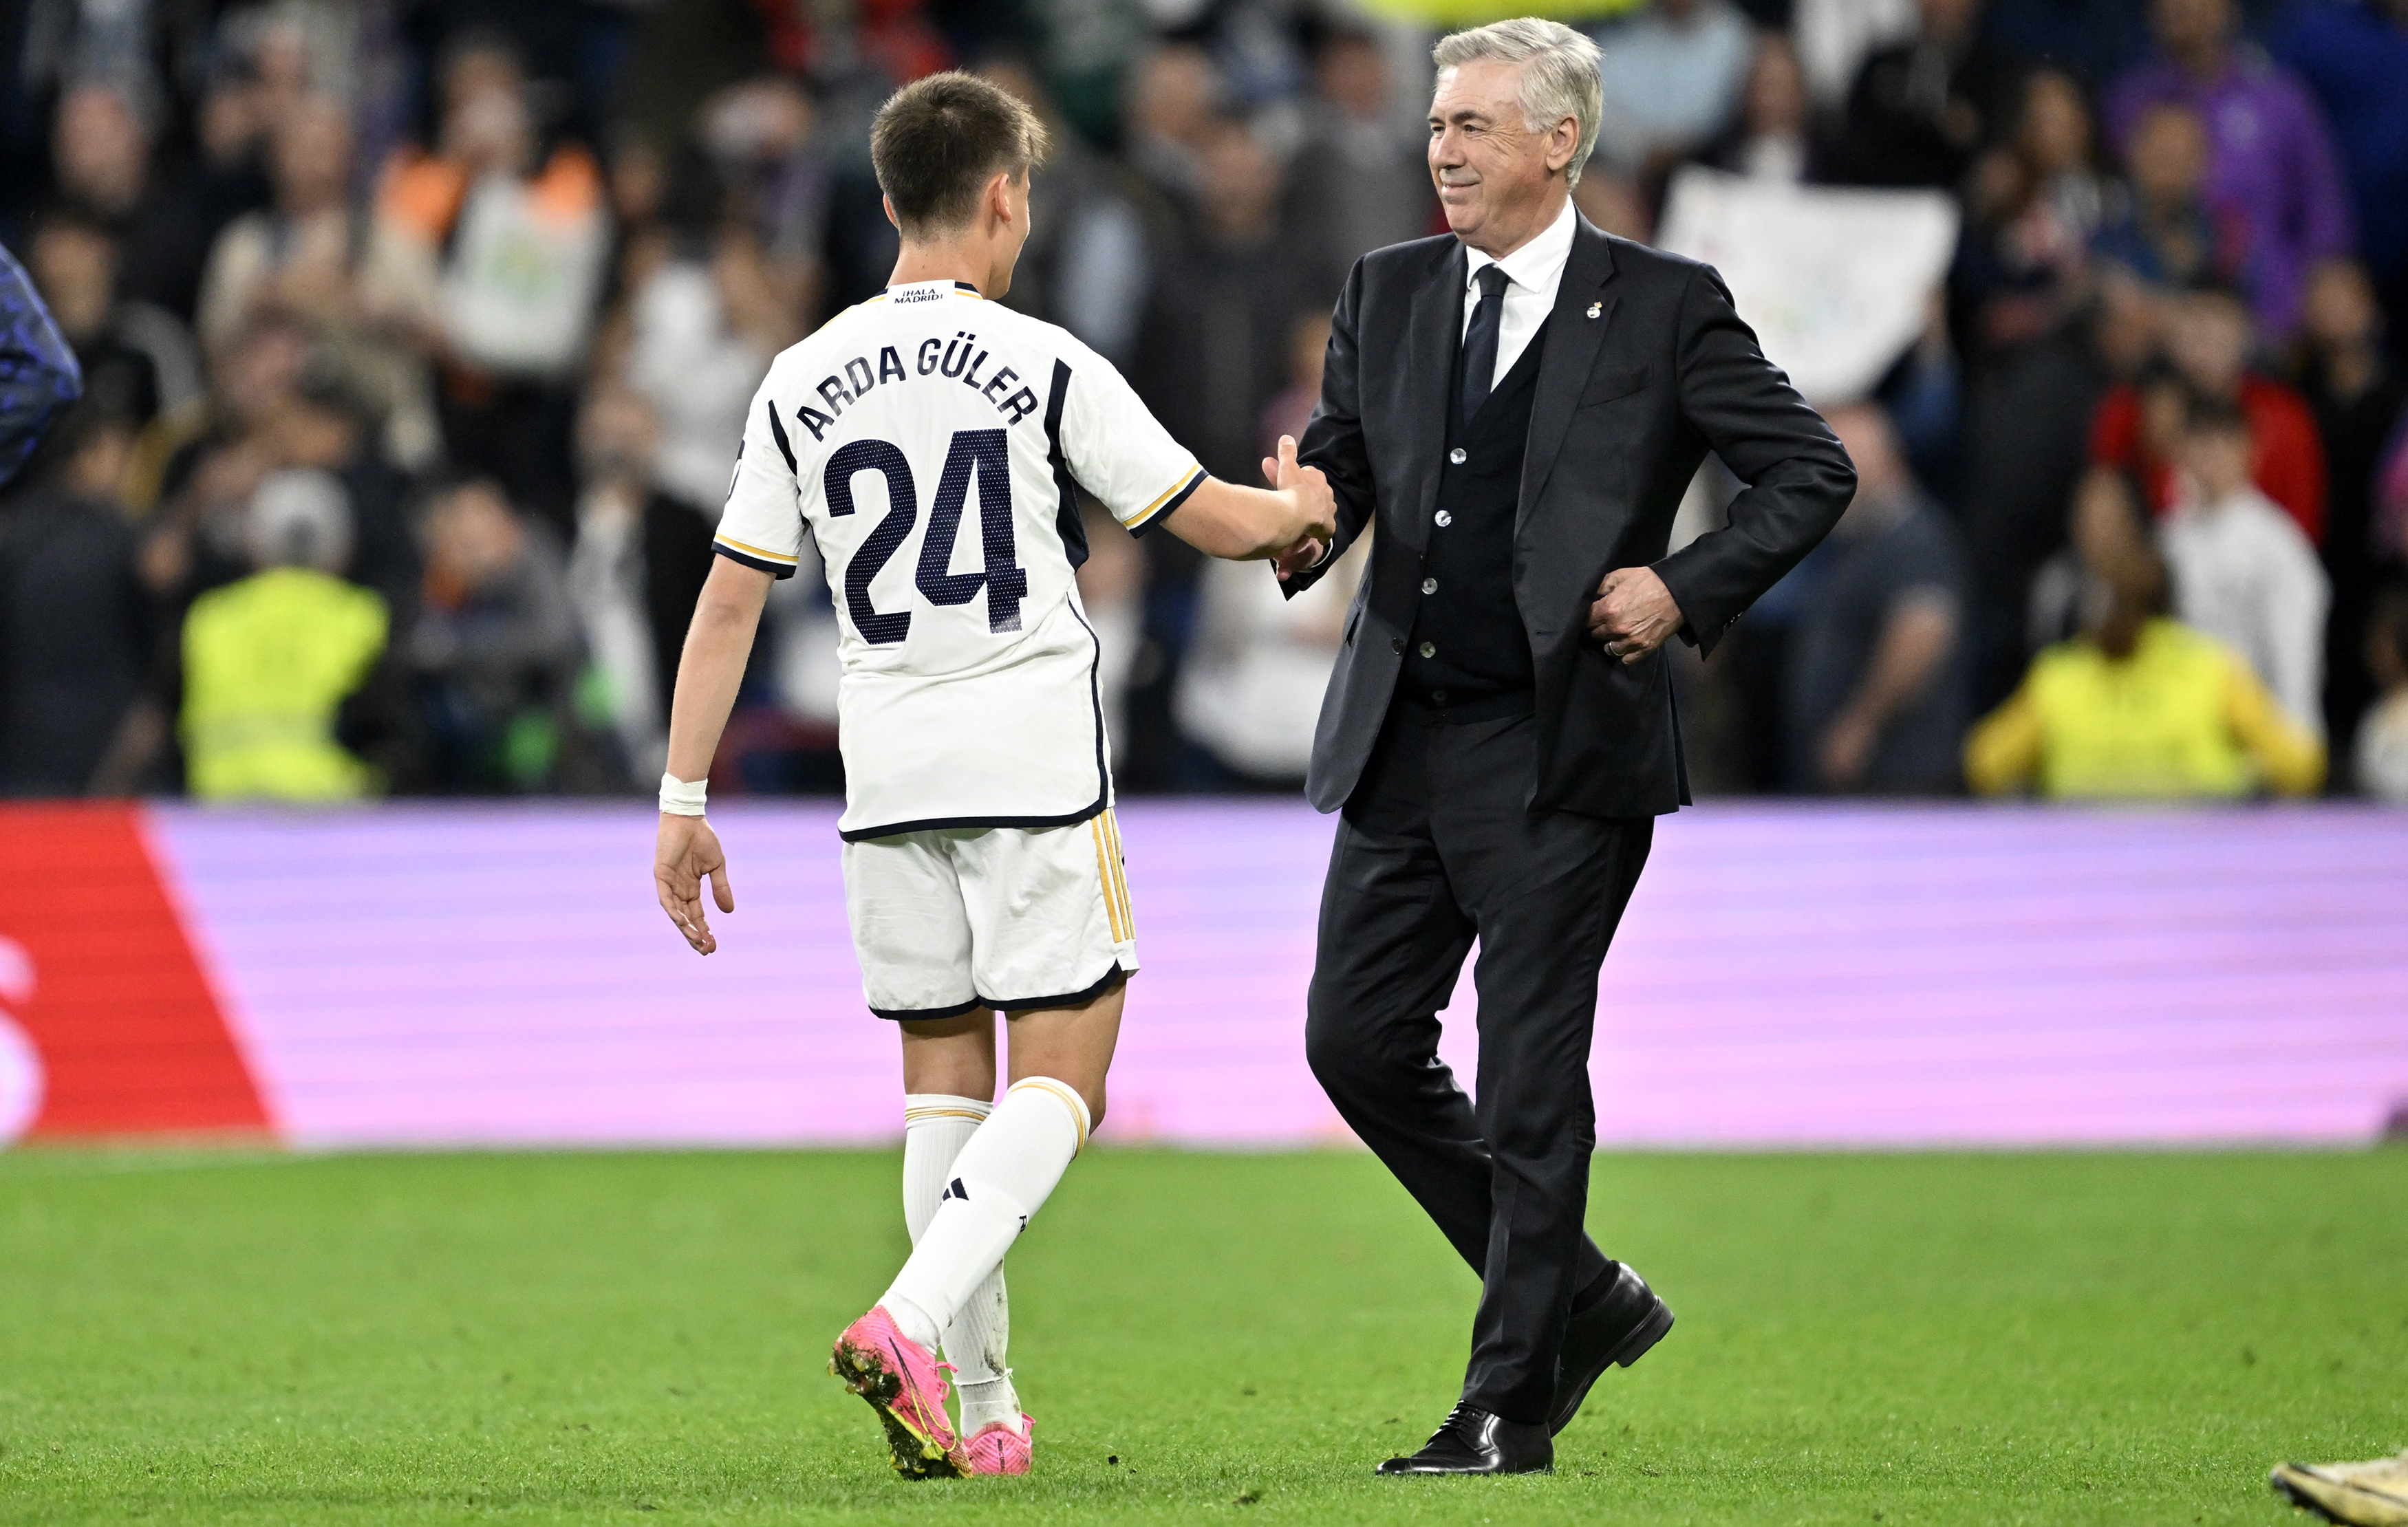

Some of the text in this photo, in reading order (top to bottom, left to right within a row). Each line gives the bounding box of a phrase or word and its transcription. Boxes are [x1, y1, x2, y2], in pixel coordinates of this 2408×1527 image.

[894, 294, 943, 304] MADRID!
[903, 288, 936, 297] ¡HALA
[796, 331, 1039, 442] ARDA GÜLER
[824, 428, 1028, 645] 24
